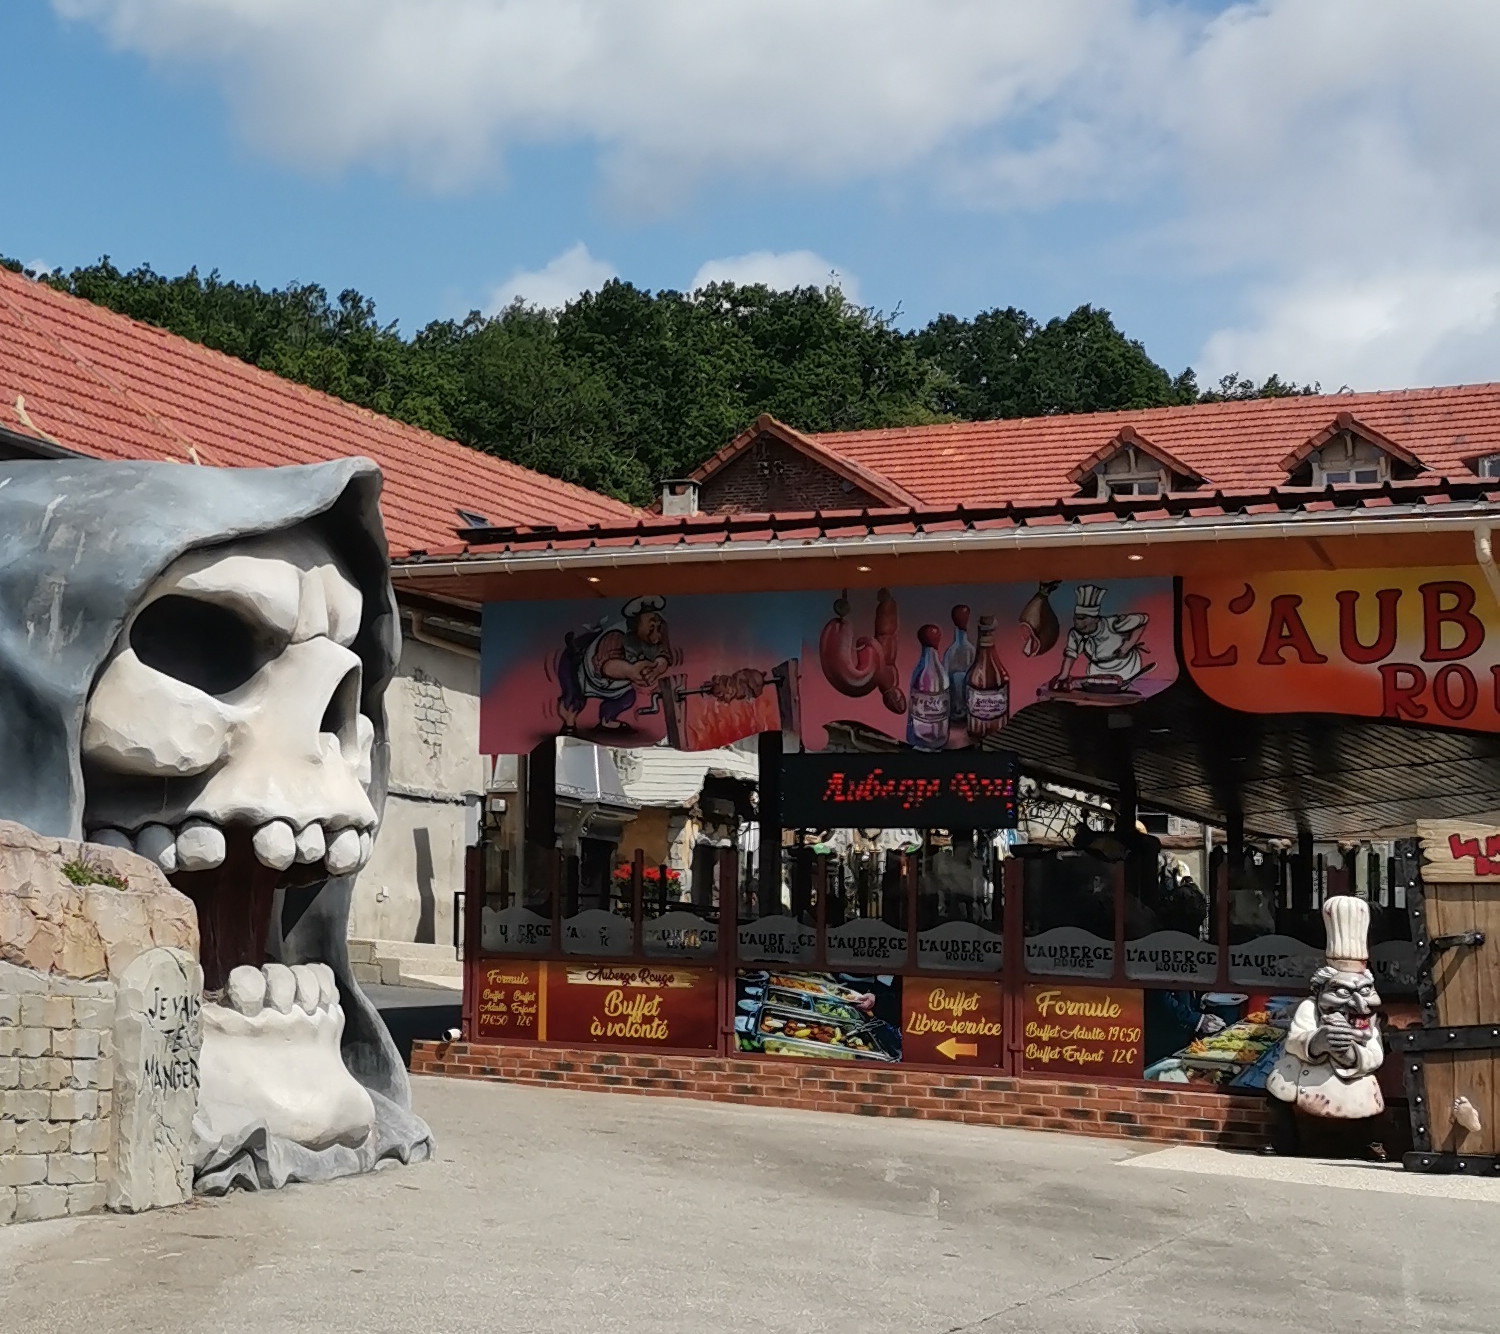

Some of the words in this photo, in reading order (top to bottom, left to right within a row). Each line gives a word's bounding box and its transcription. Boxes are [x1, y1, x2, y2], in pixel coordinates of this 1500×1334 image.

[1377, 663, 1500, 720] RO
[828, 935, 907, 950] L'AUBERGE
[919, 939, 1002, 954] L'AUBERGE
[853, 948, 890, 958] ROUGE
[946, 952, 984, 963] ROUGE
[1026, 944, 1113, 961] L'AUBERGE
[1126, 948, 1217, 966] L'AUBERGE
[1054, 957, 1094, 969] ROUGE
[1155, 962, 1198, 974] ROUGE
[486, 969, 530, 986] Formule
[586, 967, 637, 987] Auberge
[638, 967, 675, 987] Rouge
[148, 986, 168, 1021] JE
[482, 988, 505, 1003] Buffet
[512, 989, 537, 1004] Buffet
[928, 988, 982, 1017] Buffet
[1036, 990, 1122, 1018] Formule
[479, 1001, 508, 1012] Adulte
[510, 1002, 537, 1015] Enfant
[604, 989, 663, 1023] Buffet
[590, 1015, 605, 1036] à
[606, 1015, 669, 1040] volonté
[905, 1010, 1003, 1036] Libre-service
[1025, 1021, 1061, 1042] Buffet
[1060, 1024, 1106, 1041] Adulte
[1025, 1042, 1062, 1064] Buffet
[1062, 1045, 1105, 1066] Enfant
[1111, 1047, 1138, 1065] 12€
